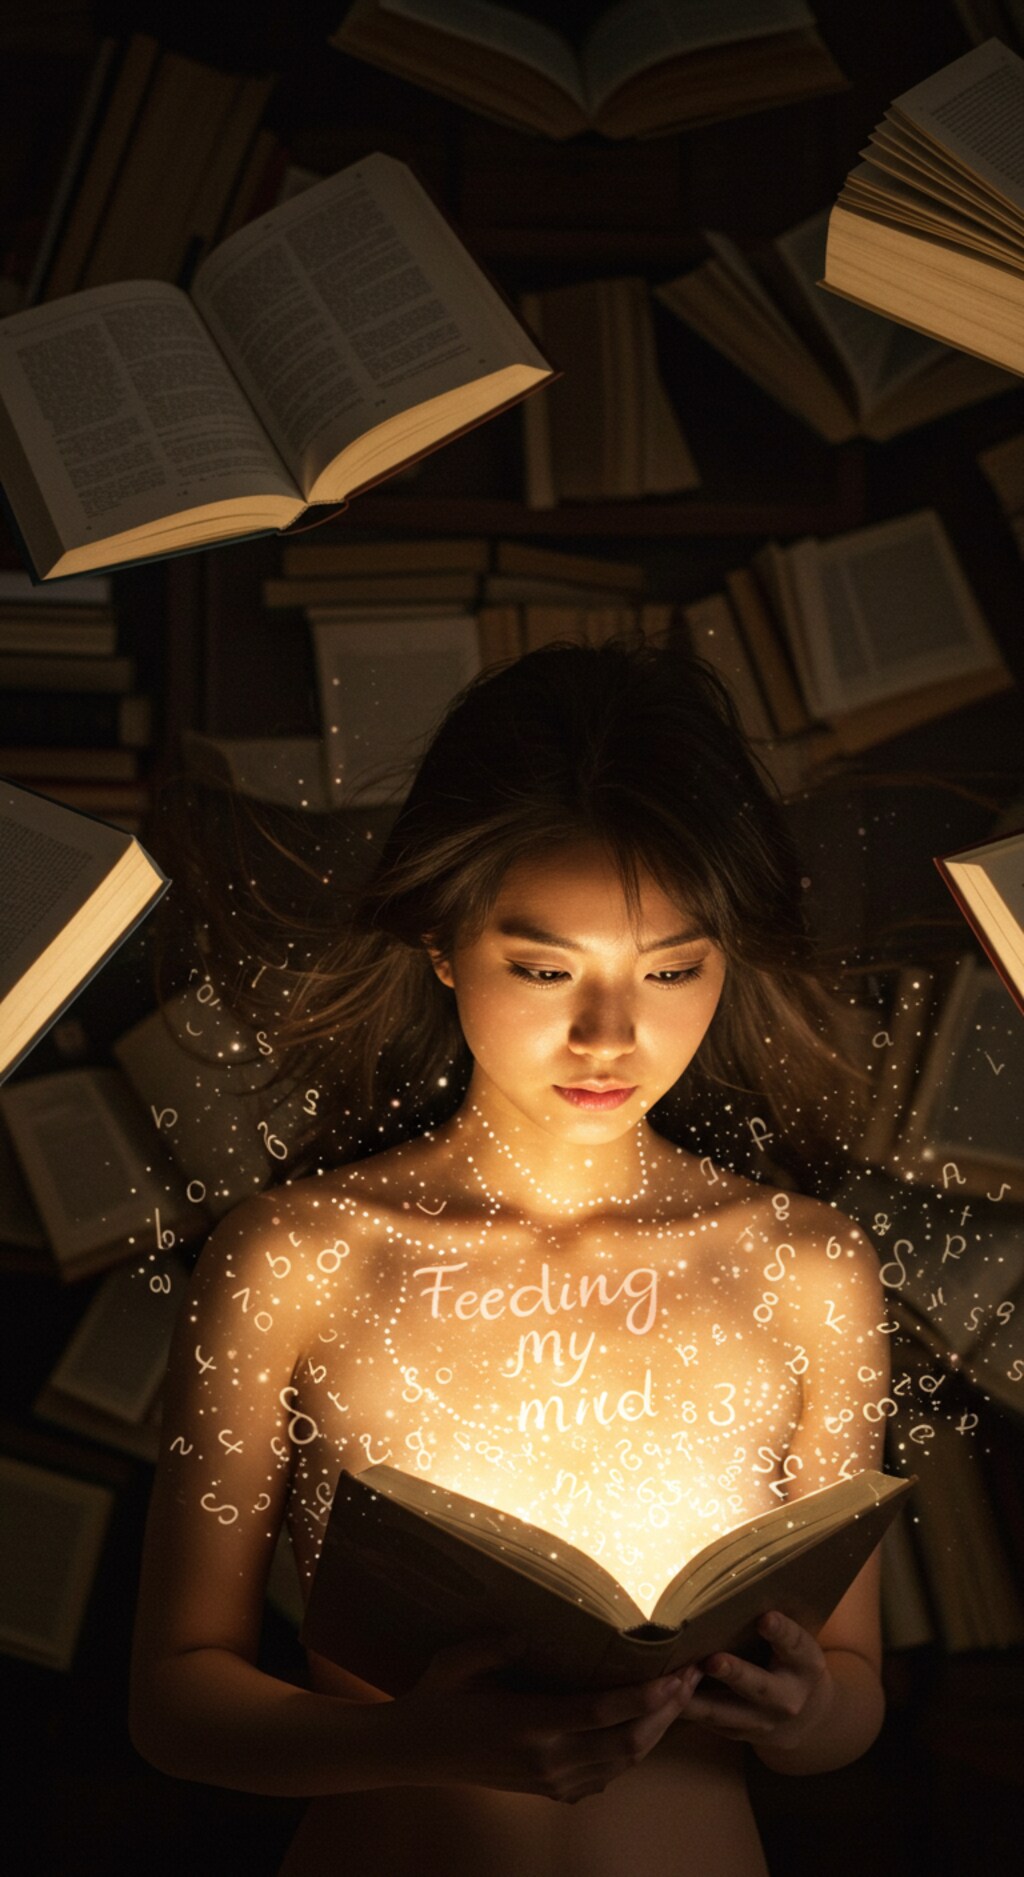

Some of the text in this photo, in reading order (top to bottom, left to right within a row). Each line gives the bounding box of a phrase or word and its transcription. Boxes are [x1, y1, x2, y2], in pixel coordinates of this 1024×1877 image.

[826, 1236, 841, 1259] 6
[681, 1401, 697, 1424] 8
[708, 1382, 736, 1426] 3
